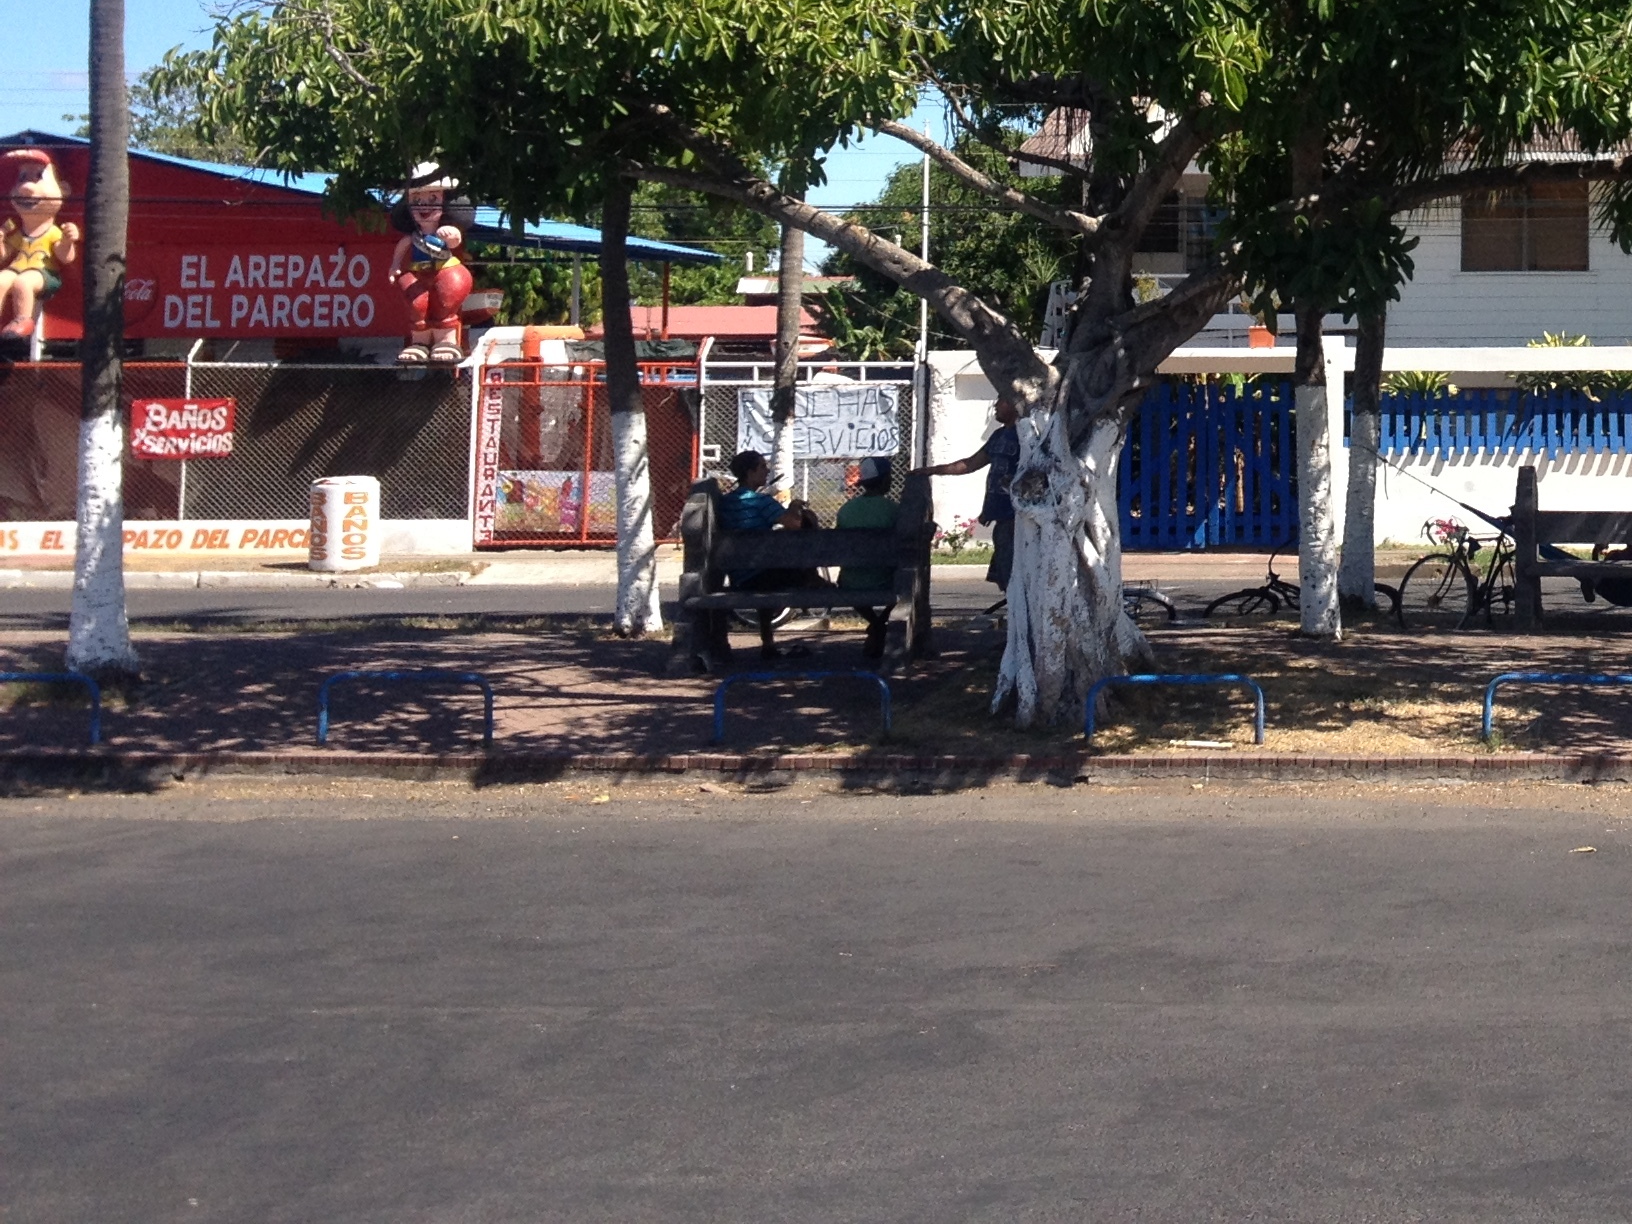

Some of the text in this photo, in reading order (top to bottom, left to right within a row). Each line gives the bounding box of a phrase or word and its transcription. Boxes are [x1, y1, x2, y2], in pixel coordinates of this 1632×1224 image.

[181, 255, 215, 288] EL
[164, 294, 374, 327] DEL PARCERO
[40, 530, 64, 550] EL
[122, 529, 183, 549] PAZO
[190, 529, 230, 549] DEL
